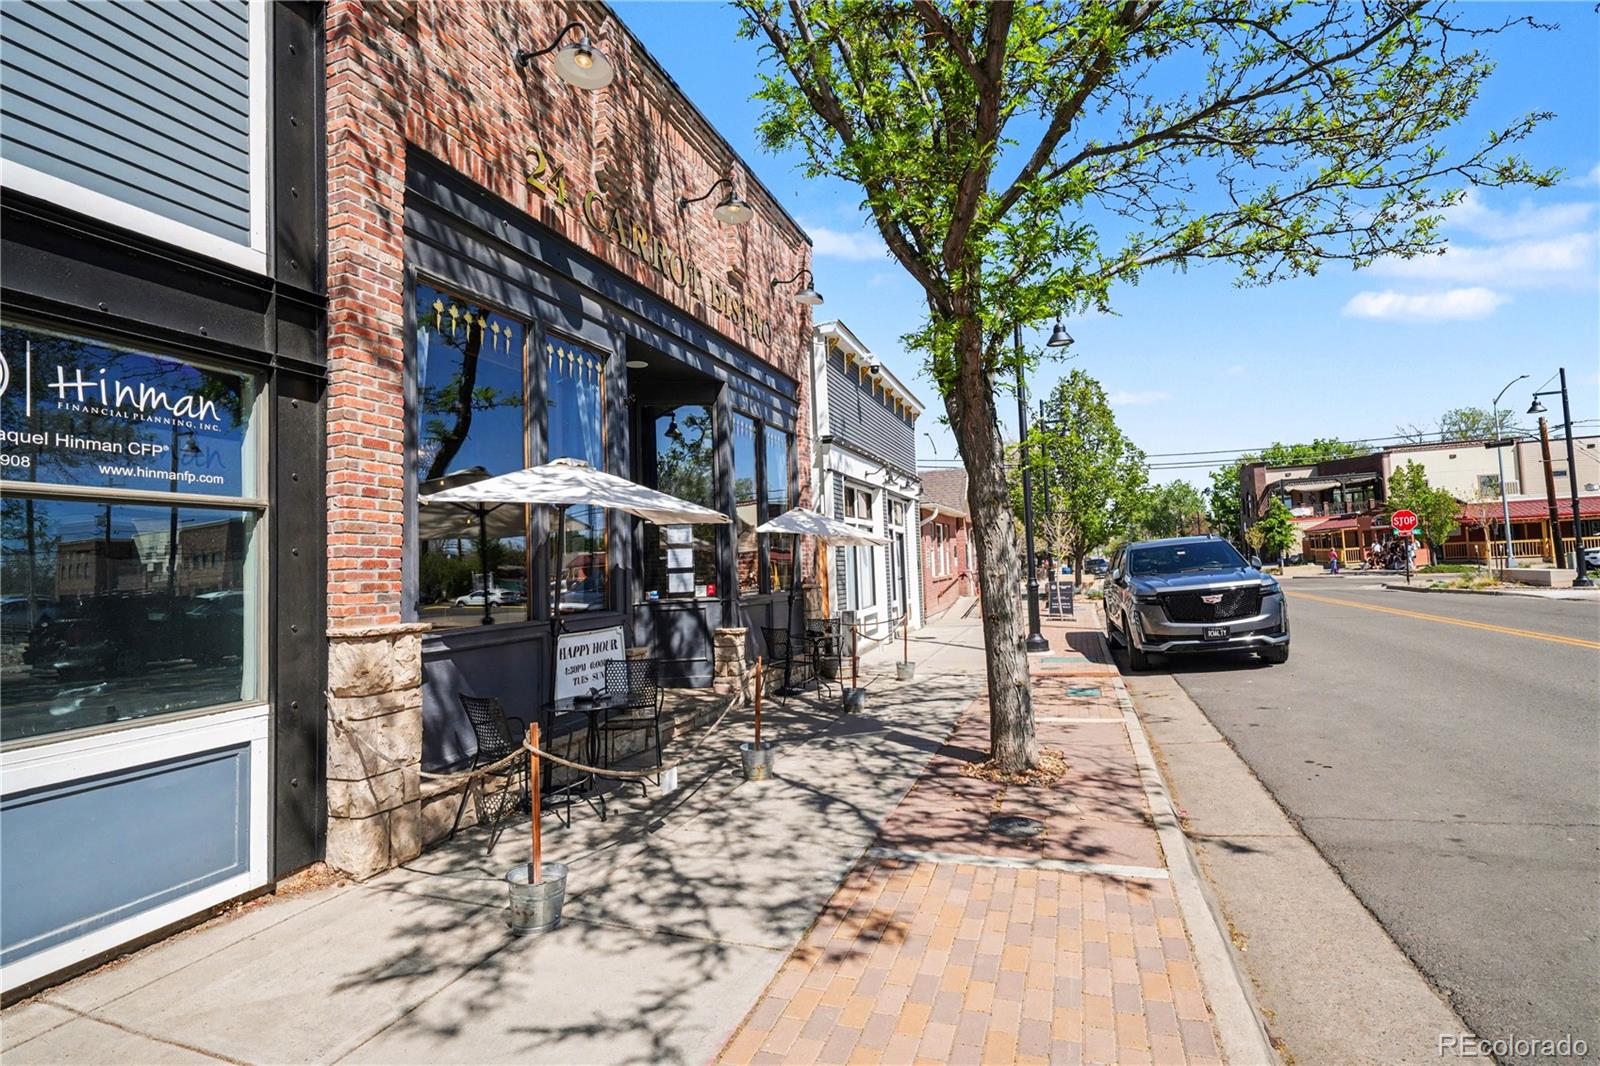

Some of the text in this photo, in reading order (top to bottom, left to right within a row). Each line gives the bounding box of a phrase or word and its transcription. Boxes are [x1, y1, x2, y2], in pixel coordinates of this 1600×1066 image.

[525, 146, 568, 208] 24
[583, 191, 702, 298] CARROT
[48, 365, 221, 422] Hinman
[57, 401, 130, 419] FINANCIAL
[200, 422, 222, 433] INC.
[55, 432, 123, 454] Hinman
[0, 453, 31, 468] 908
[98, 464, 224, 485] www.hinmanfp.com
[1393, 516, 1415, 526] STOP
[560, 639, 618, 660] HAPPY HOUR
[573, 675, 588, 686] TUES
